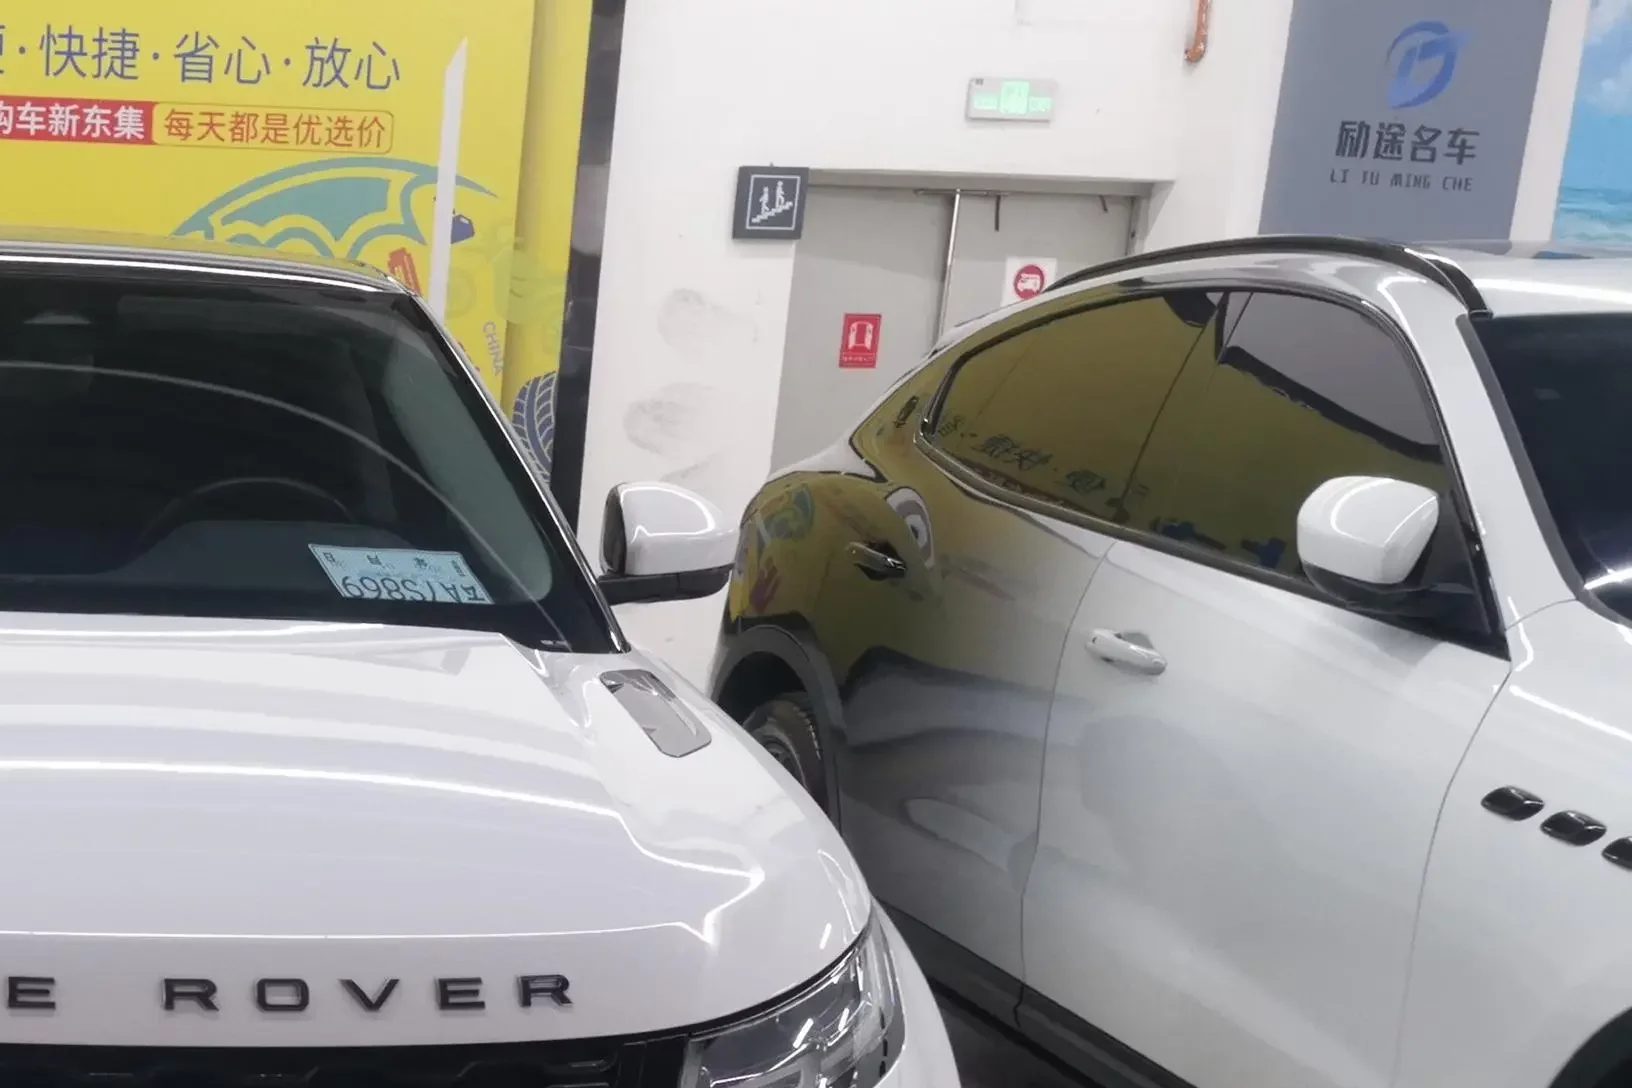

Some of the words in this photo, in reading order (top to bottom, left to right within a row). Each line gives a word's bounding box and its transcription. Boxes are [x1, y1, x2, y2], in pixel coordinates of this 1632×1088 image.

[163, 108, 386, 148] 每天都是优选价
[1335, 120, 1480, 165] 励途名车
[1329, 168, 1350, 184] LI
[1362, 170, 1380, 186] TU
[1390, 173, 1432, 189] MING
[1442, 176, 1473, 191] CHE
[161, 974, 573, 1012] ROVER
